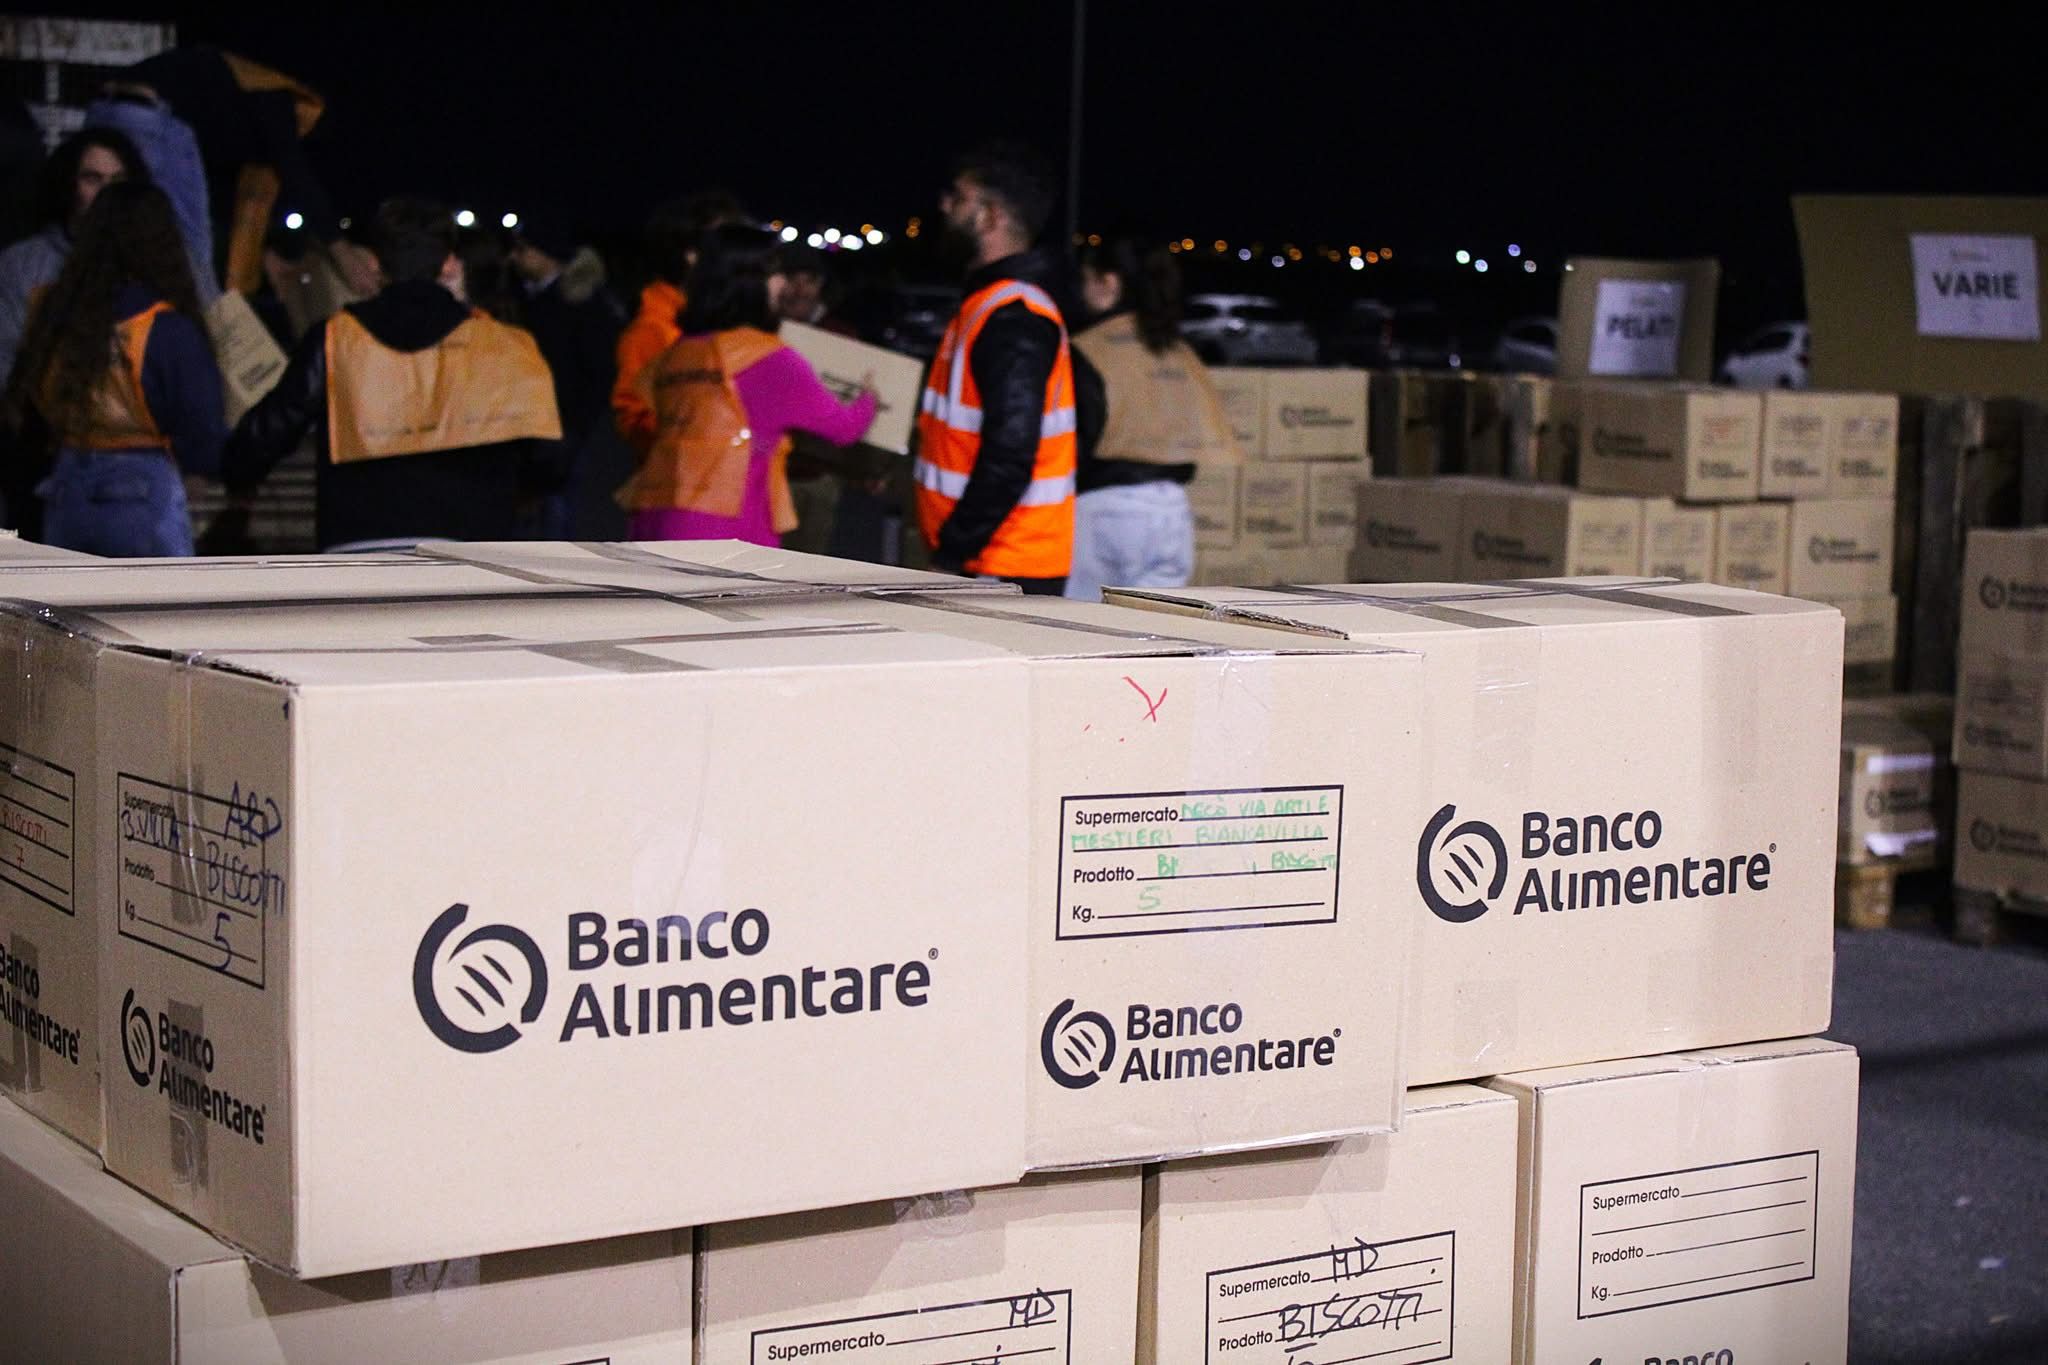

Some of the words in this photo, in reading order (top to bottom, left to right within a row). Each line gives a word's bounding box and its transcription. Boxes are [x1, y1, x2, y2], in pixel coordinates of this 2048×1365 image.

[1932, 271, 2018, 300] VARIE
[1075, 807, 1178, 827] Supermercato
[1239, 800, 1265, 816] VIA
[1071, 829, 1172, 850] MESTIERI
[1522, 810, 1662, 858] Banco
[1073, 867, 1134, 883] Prodotto
[1072, 904, 1095, 923] Kg.
[568, 908, 769, 970] Banco
[1127, 1003, 1242, 1040] Banco
[159, 1012, 214, 1073] Banco
[1592, 1186, 1680, 1210] Supermercato
[1331, 1237, 1378, 1282] MD
[1592, 1246, 1644, 1264] Prodotto
[1219, 1270, 1310, 1297] Supermercato
[1591, 1286, 1611, 1301] Kg.
[1009, 1288, 1055, 1327] MD
[768, 1331, 885, 1361] Supermercato
[1219, 1331, 1273, 1351] Prodotto
